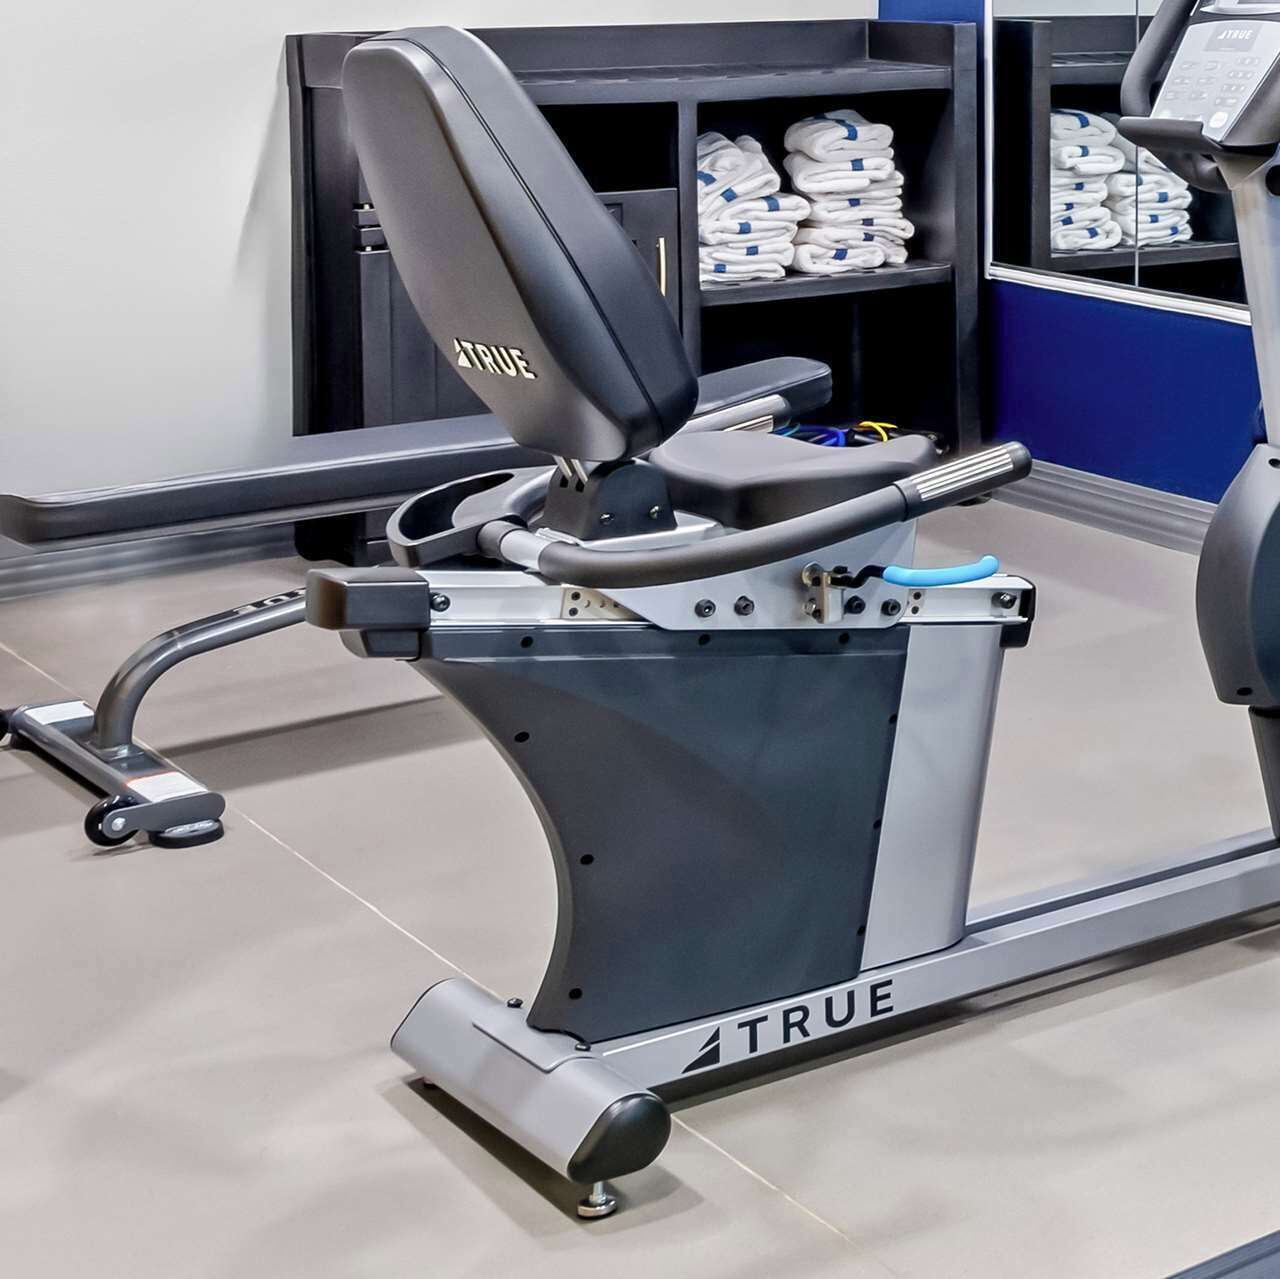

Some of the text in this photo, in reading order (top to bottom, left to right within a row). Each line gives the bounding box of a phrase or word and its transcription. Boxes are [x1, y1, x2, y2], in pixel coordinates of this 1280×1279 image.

[1227, 29, 1253, 40] TRUE
[460, 339, 537, 380] TRUE
[737, 979, 894, 1054] TRUE
